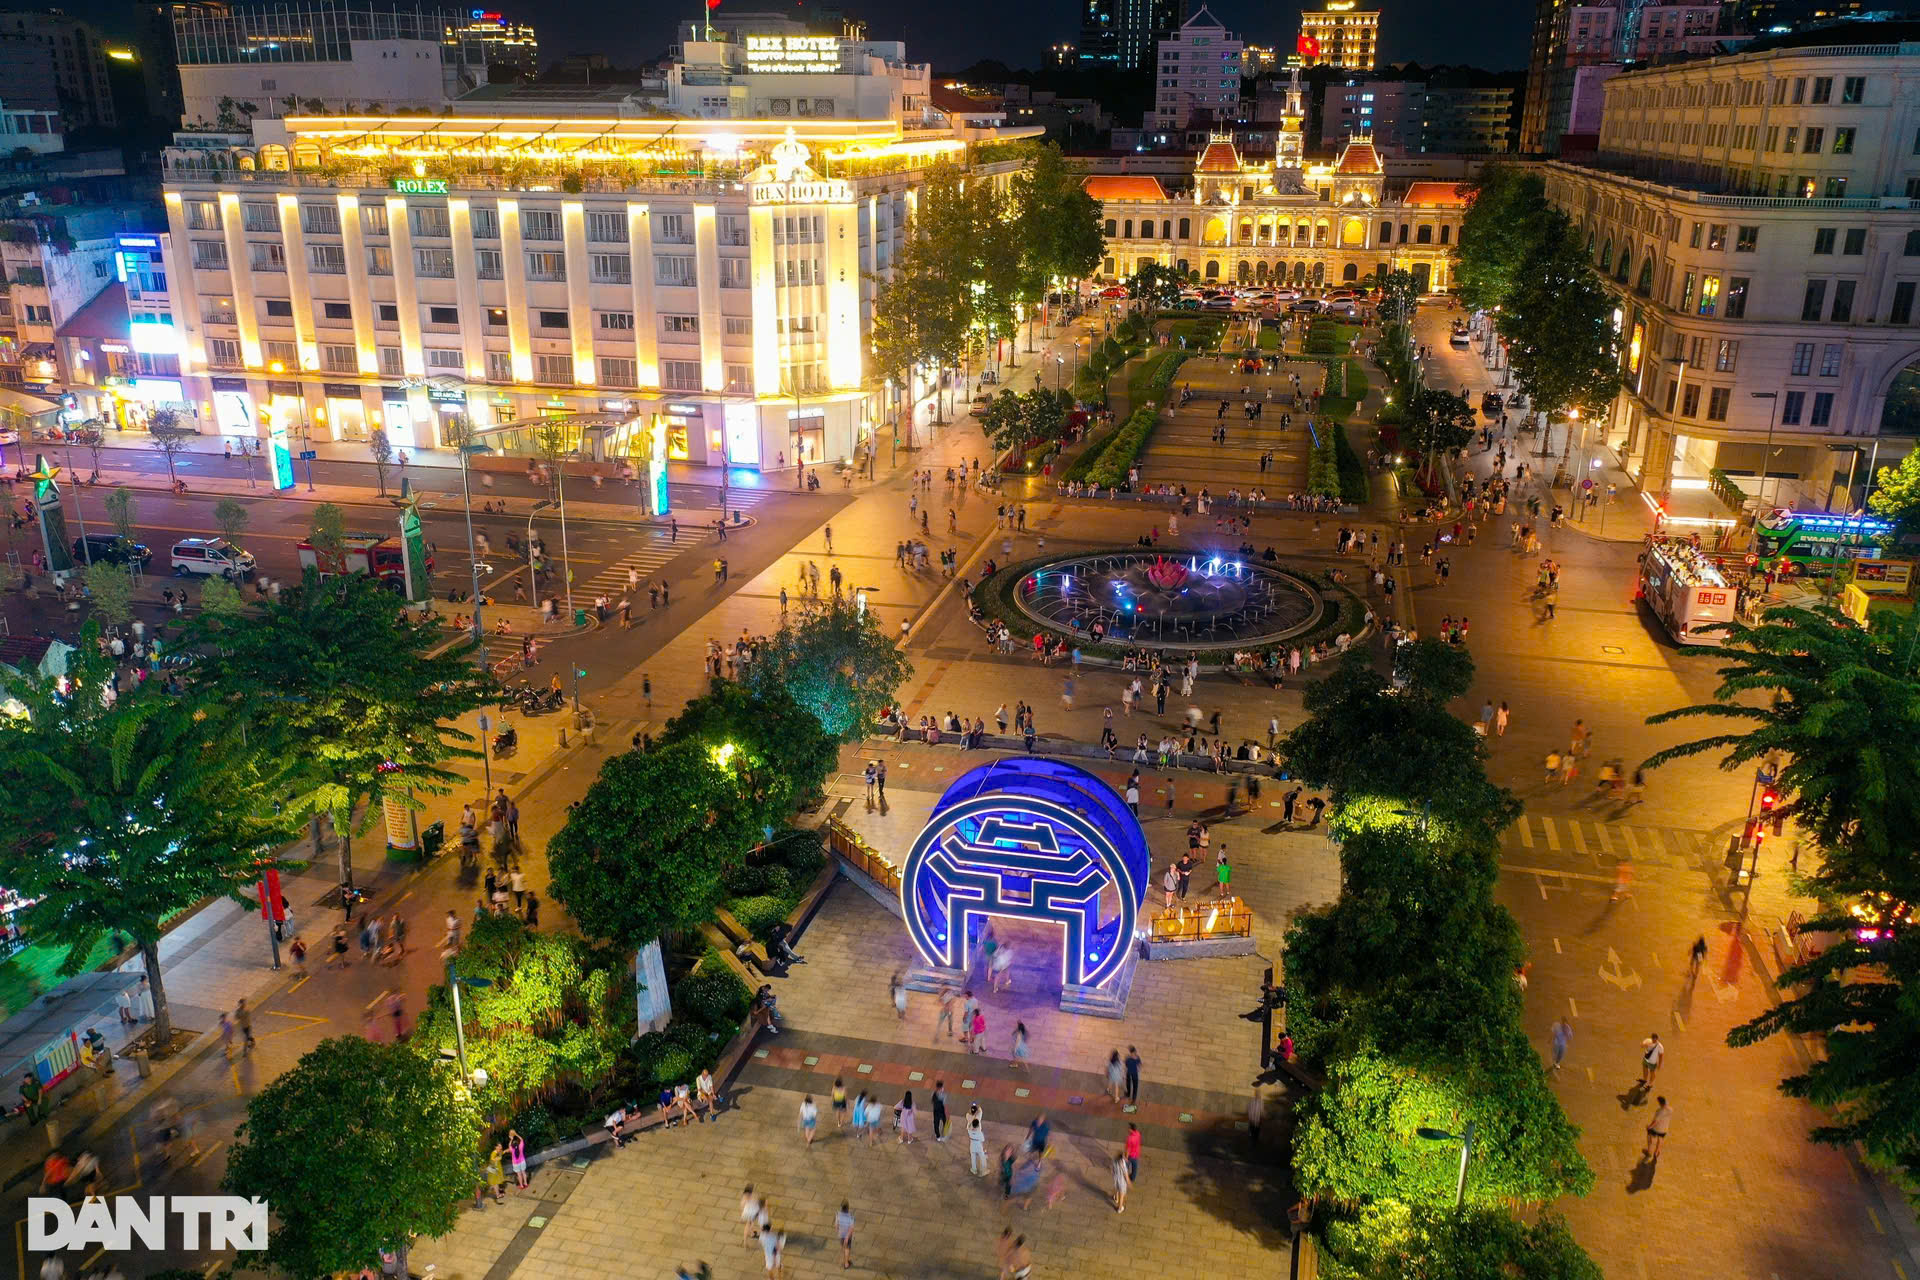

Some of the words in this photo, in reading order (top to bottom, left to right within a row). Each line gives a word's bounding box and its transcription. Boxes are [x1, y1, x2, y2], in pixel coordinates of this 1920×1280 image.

[746, 37, 783, 50] REX
[785, 37, 840, 50] HOTEL
[396, 180, 448, 193] ROLEX
[756, 187, 785, 200] REX
[791, 185, 853, 200] HOTEL
